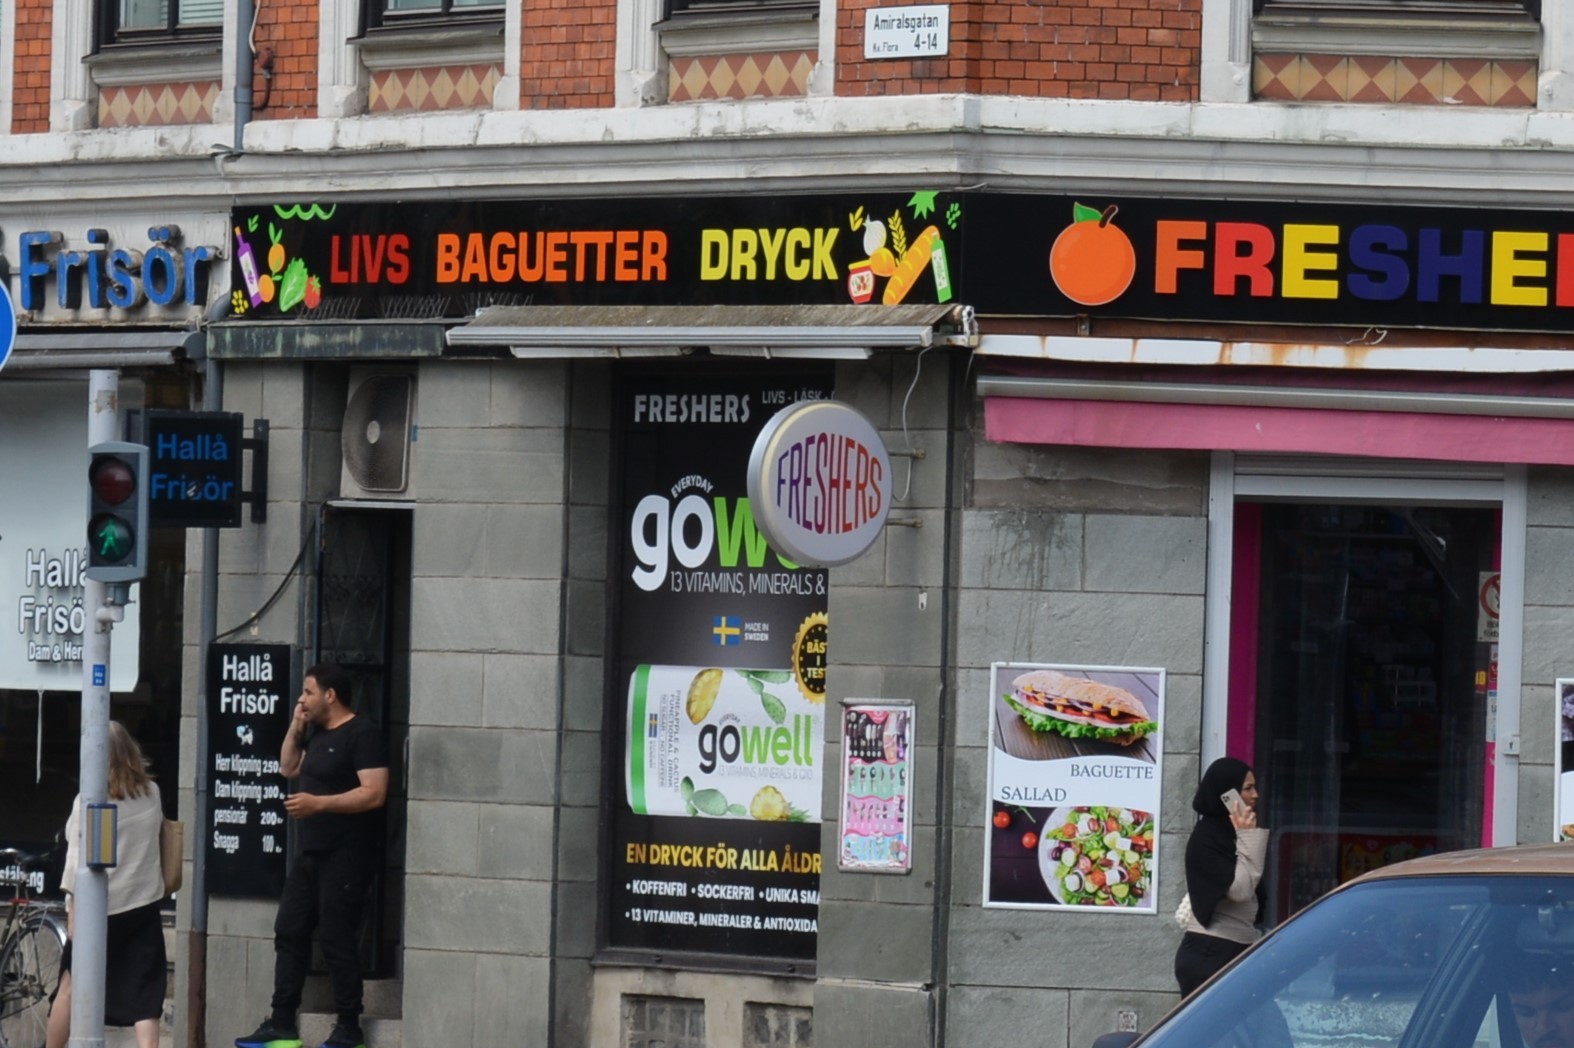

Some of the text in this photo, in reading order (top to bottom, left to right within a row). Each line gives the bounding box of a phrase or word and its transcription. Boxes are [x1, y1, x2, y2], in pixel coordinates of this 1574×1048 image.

[873, 13, 939, 33] Amiralsgatan
[882, 42, 899, 52] Flora
[913, 33, 938, 50] 4-14
[330, 227, 839, 284] LIVS BAGUETTER DRYCK
[19, 226, 214, 311] Frisör
[633, 394, 750, 423] FRESHERS
[761, 390, 786, 404] LIVS
[157, 432, 229, 461] Hallå
[150, 473, 234, 501] Frisör
[670, 475, 714, 500] EVERYDAY
[776, 432, 882, 535] FRESHERS
[631, 494, 801, 592] gow
[670, 571, 826, 596] 13 VITAMINS, MINERALS &
[19, 596, 85, 634] Frisö
[744, 632, 769, 641] SWEDEN
[28, 641, 51, 661] Dam
[52, 644, 61, 662] &
[222, 652, 273, 681] Hallå
[220, 687, 279, 714] Frisör
[698, 714, 813, 775] gowell
[215, 753, 279, 777] Herr klippning 250
[1070, 763, 1154, 779] BAGUETTE
[215, 779, 231, 798] Dam
[231, 780, 262, 804] klippning
[262, 785, 279, 799] 300
[1001, 786, 1067, 802] SALLAD
[214, 806, 248, 827] pensionär
[260, 811, 278, 825] 200
[214, 830, 240, 854] Snagga
[262, 835, 275, 853] 100
[626, 843, 647, 864] EN
[650, 844, 704, 868] DRYCK
[706, 842, 738, 870] FÖR
[740, 848, 779, 872] ALLA
[697, 883, 755, 901] SOCKERFRI
[765, 887, 799, 903] UNIKA
[631, 908, 818, 932] 13 VITAMINER, MINERALER & ANTIOXIDA
